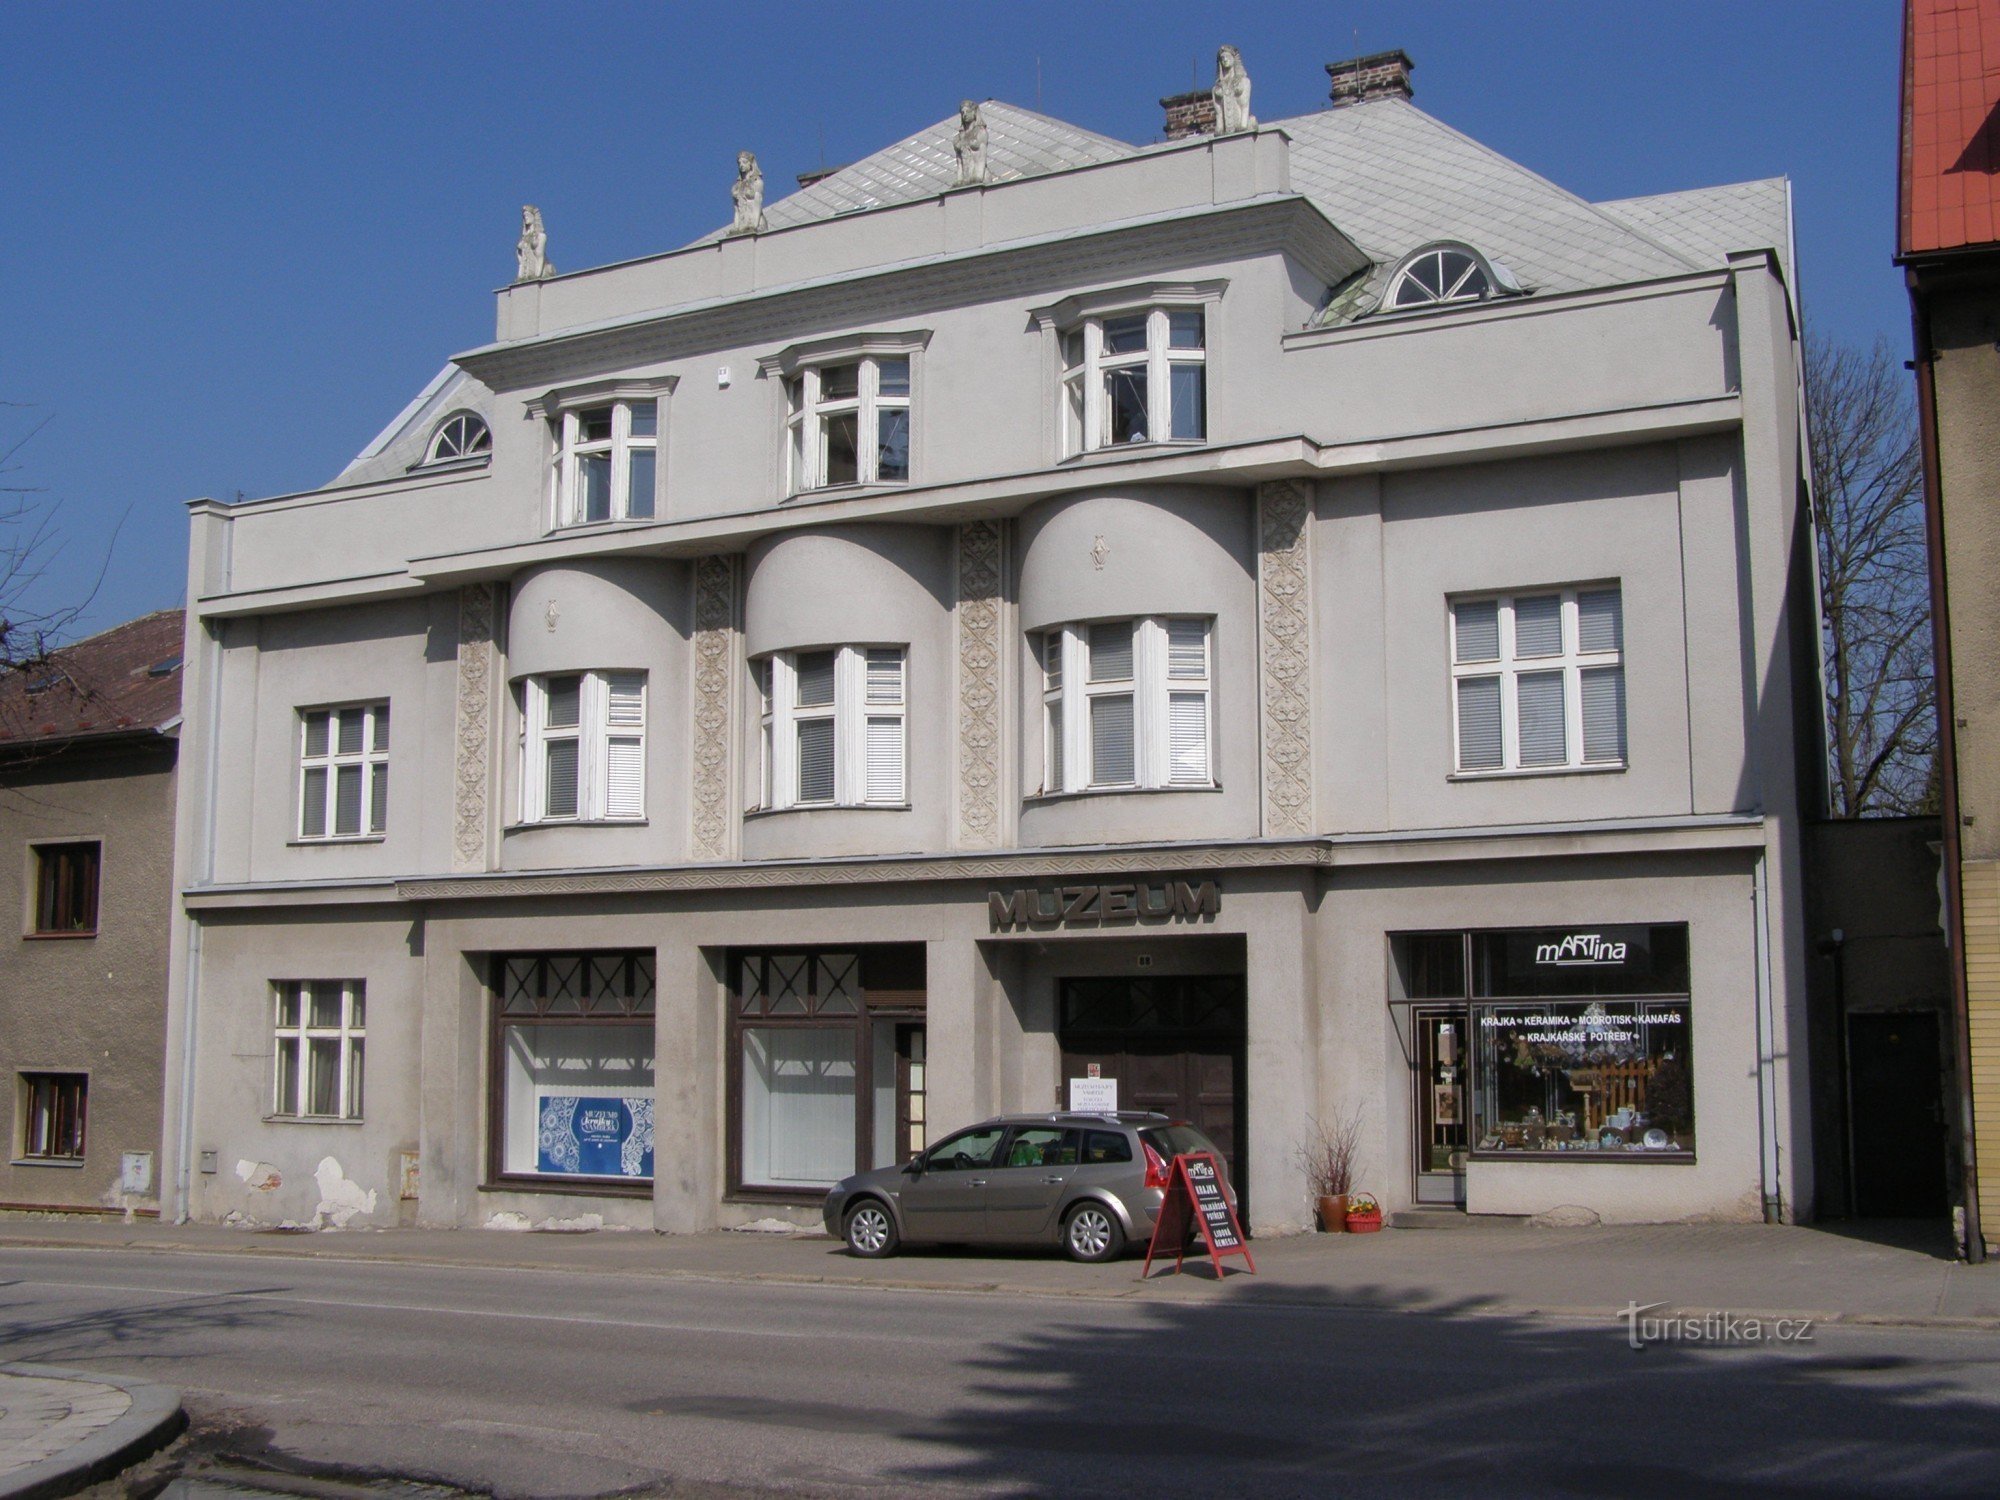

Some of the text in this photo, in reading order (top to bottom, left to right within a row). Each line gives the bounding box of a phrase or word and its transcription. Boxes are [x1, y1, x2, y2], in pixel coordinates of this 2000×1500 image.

[988, 881, 1218, 926] MUZEUM
[1536, 934, 1627, 962] mARTina
[1481, 1014, 1681, 1027] KRAJKA KERAMIKA MODROTISK KANAFAS
[1527, 1031, 1632, 1042] KRAJKÁŘSKÉ POTŘEBY
[1195, 1184, 1218, 1195] KRAJKA
